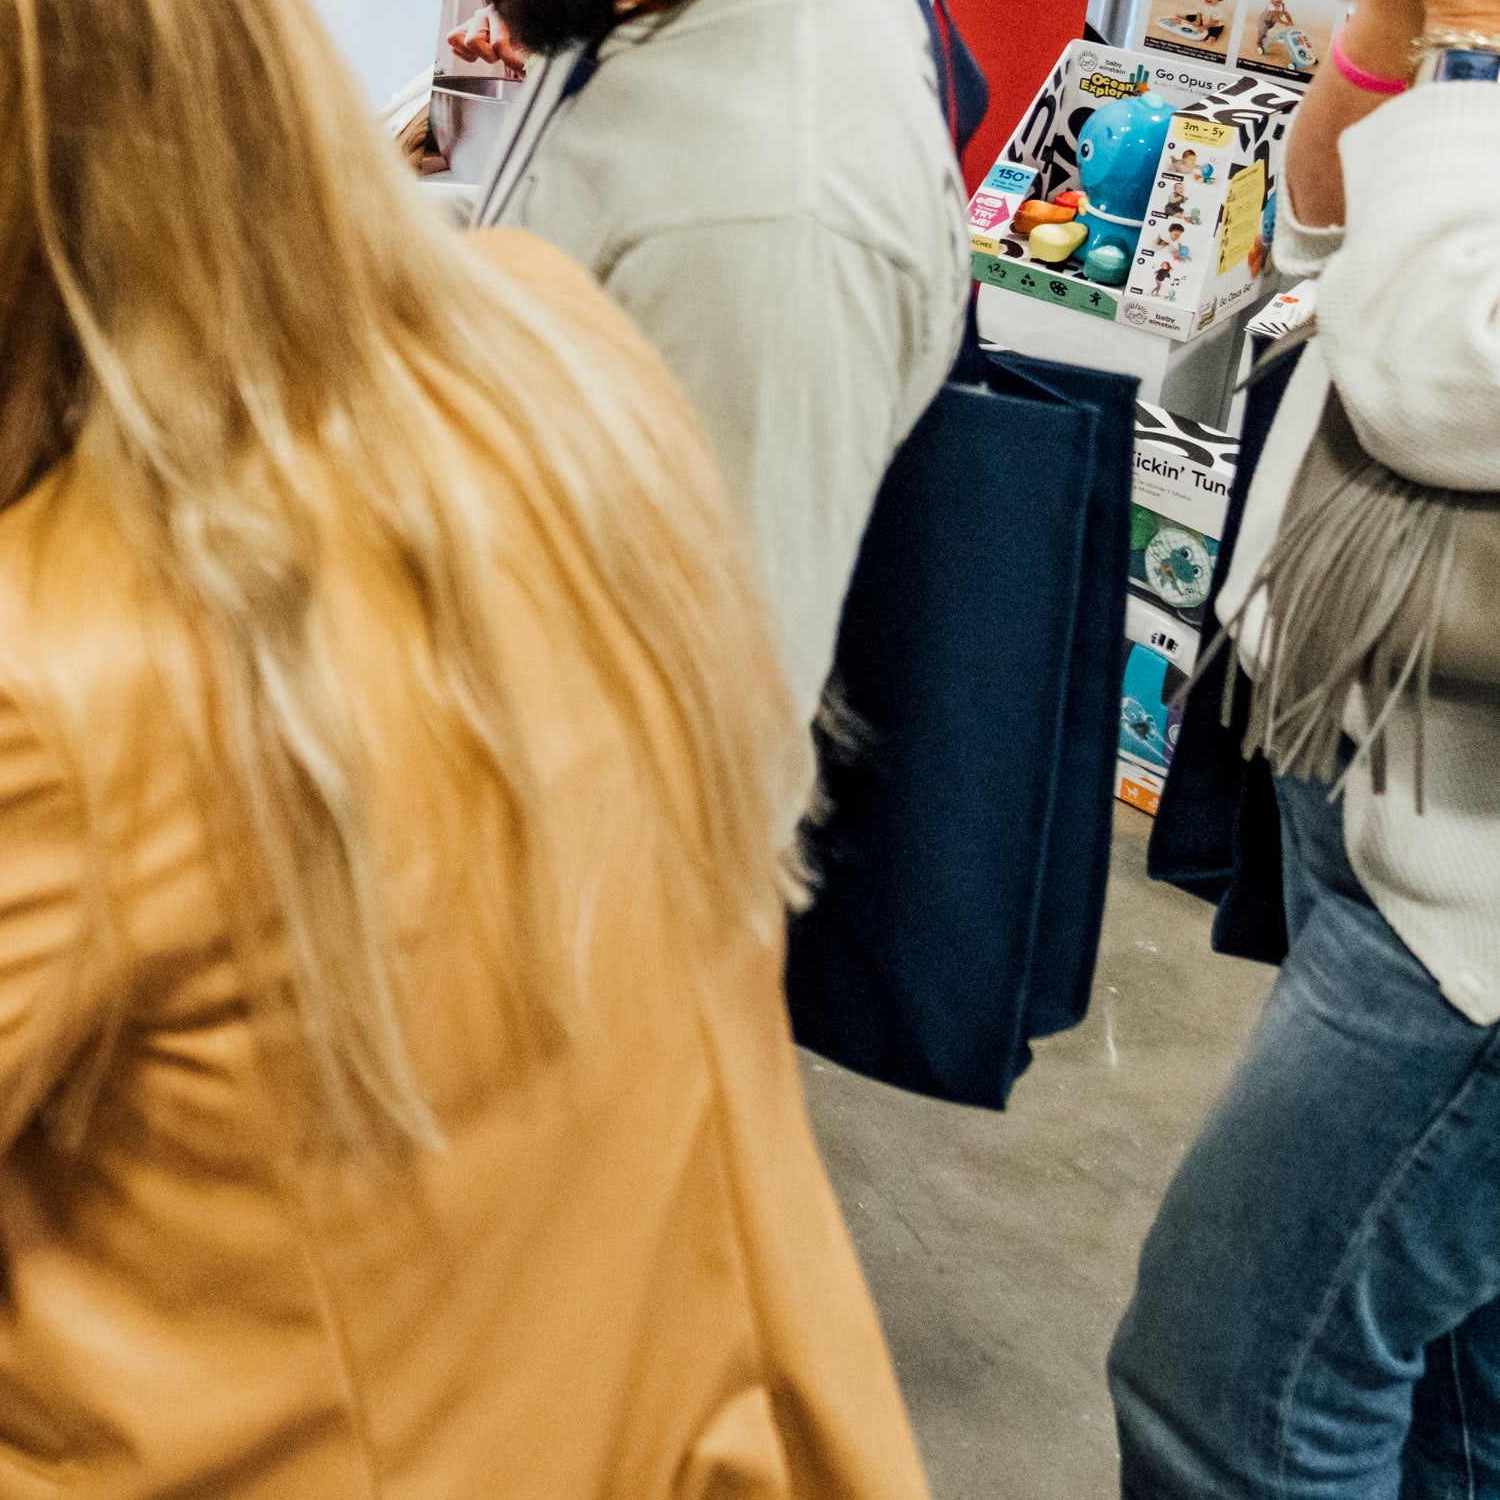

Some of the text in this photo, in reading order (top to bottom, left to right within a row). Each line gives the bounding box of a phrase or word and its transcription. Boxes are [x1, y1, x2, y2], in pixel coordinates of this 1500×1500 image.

[1098, 64, 1126, 76] einstein
[1105, 58, 1123, 69] baby
[1091, 72, 1135, 94] Ocean
[1155, 68, 1175, 82] Go
[1178, 73, 1213, 90] Opus
[1183, 121, 1199, 132] 3m
[1211, 126, 1225, 138] 5y
[998, 168, 1031, 182] 150+
[973, 208, 997, 220] TRY
[969, 216, 992, 227] ME!
[1148, 318, 1181, 332] einstein
[1155, 312, 1176, 324] baby
[1132, 451, 1185, 481] ickin’
